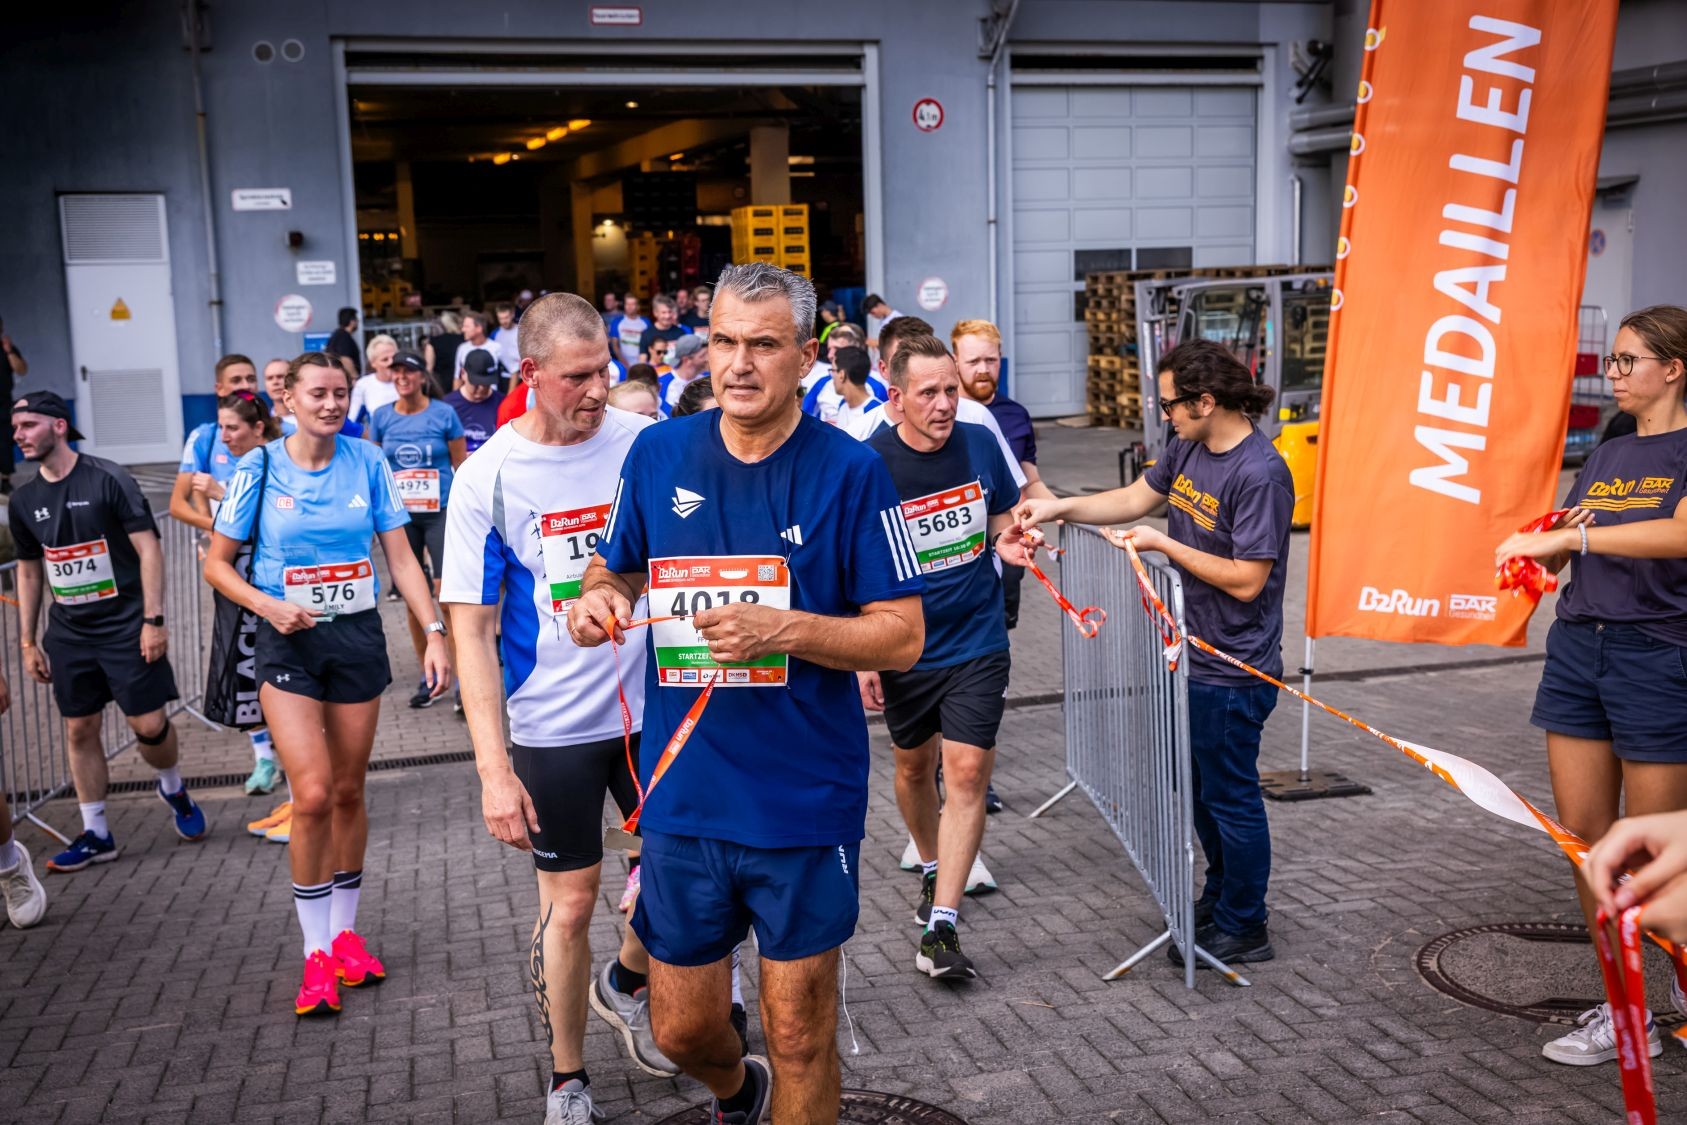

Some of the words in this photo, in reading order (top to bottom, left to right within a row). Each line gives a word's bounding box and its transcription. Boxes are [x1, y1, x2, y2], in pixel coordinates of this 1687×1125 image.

[1409, 15, 1541, 505] MEDAILLEN
[398, 480, 430, 491] 4975
[1587, 478, 1635, 496] B2Run
[1641, 477, 1674, 489] DAK
[550, 517, 580, 529] B2Run
[917, 506, 972, 537] 5683
[53, 558, 97, 577] 3074
[658, 567, 689, 579] B2Run
[311, 583, 355, 604] 576
[1358, 586, 1440, 617] B2Run
[1449, 594, 1497, 613] DAK
